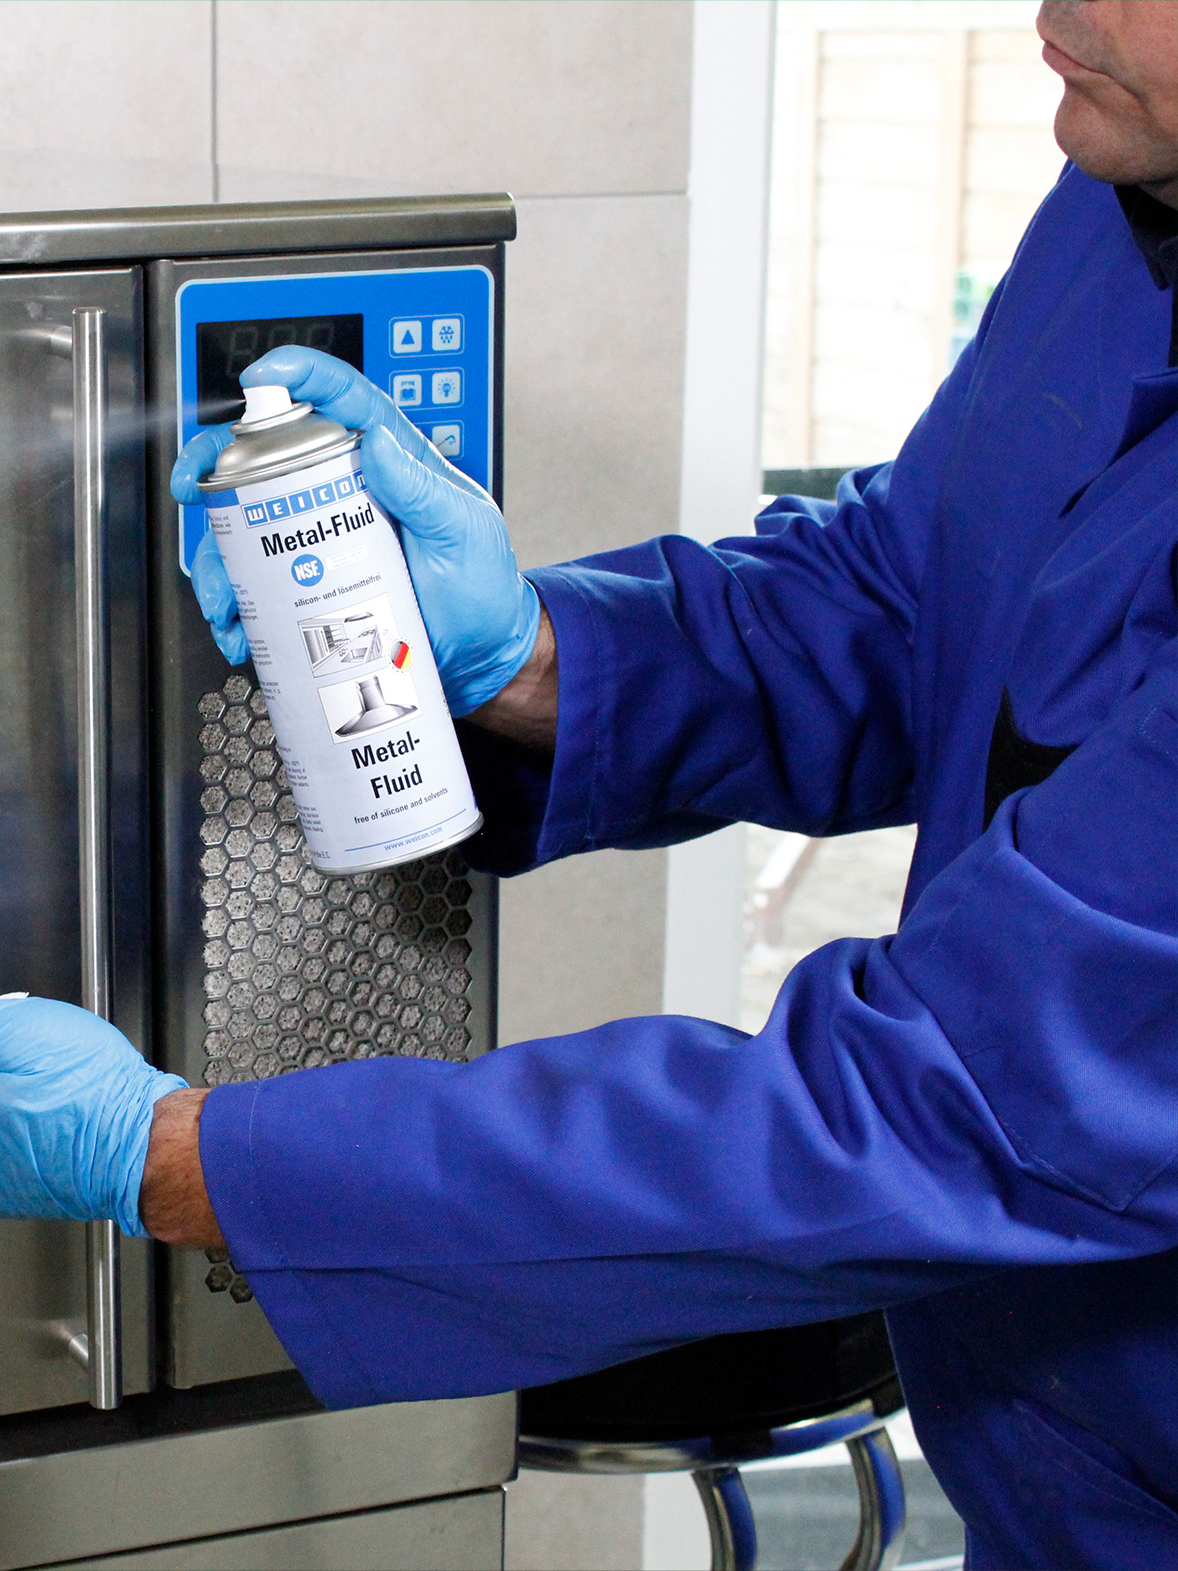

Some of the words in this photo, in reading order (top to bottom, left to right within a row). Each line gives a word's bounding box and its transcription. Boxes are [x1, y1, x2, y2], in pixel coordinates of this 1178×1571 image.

[260, 502, 375, 557] Metal-Fluid
[294, 595, 322, 608] silicon-
[322, 589, 337, 600] und
[337, 572, 381, 595] lösemittelfrei
[351, 731, 421, 770] Metal-
[370, 764, 423, 799] Fluid
[354, 816, 369, 824] free
[370, 811, 379, 820] of
[380, 804, 409, 818] silicone
[410, 798, 423, 809] and
[424, 787, 448, 803] solvents
[383, 826, 443, 851] www.weicon.com
